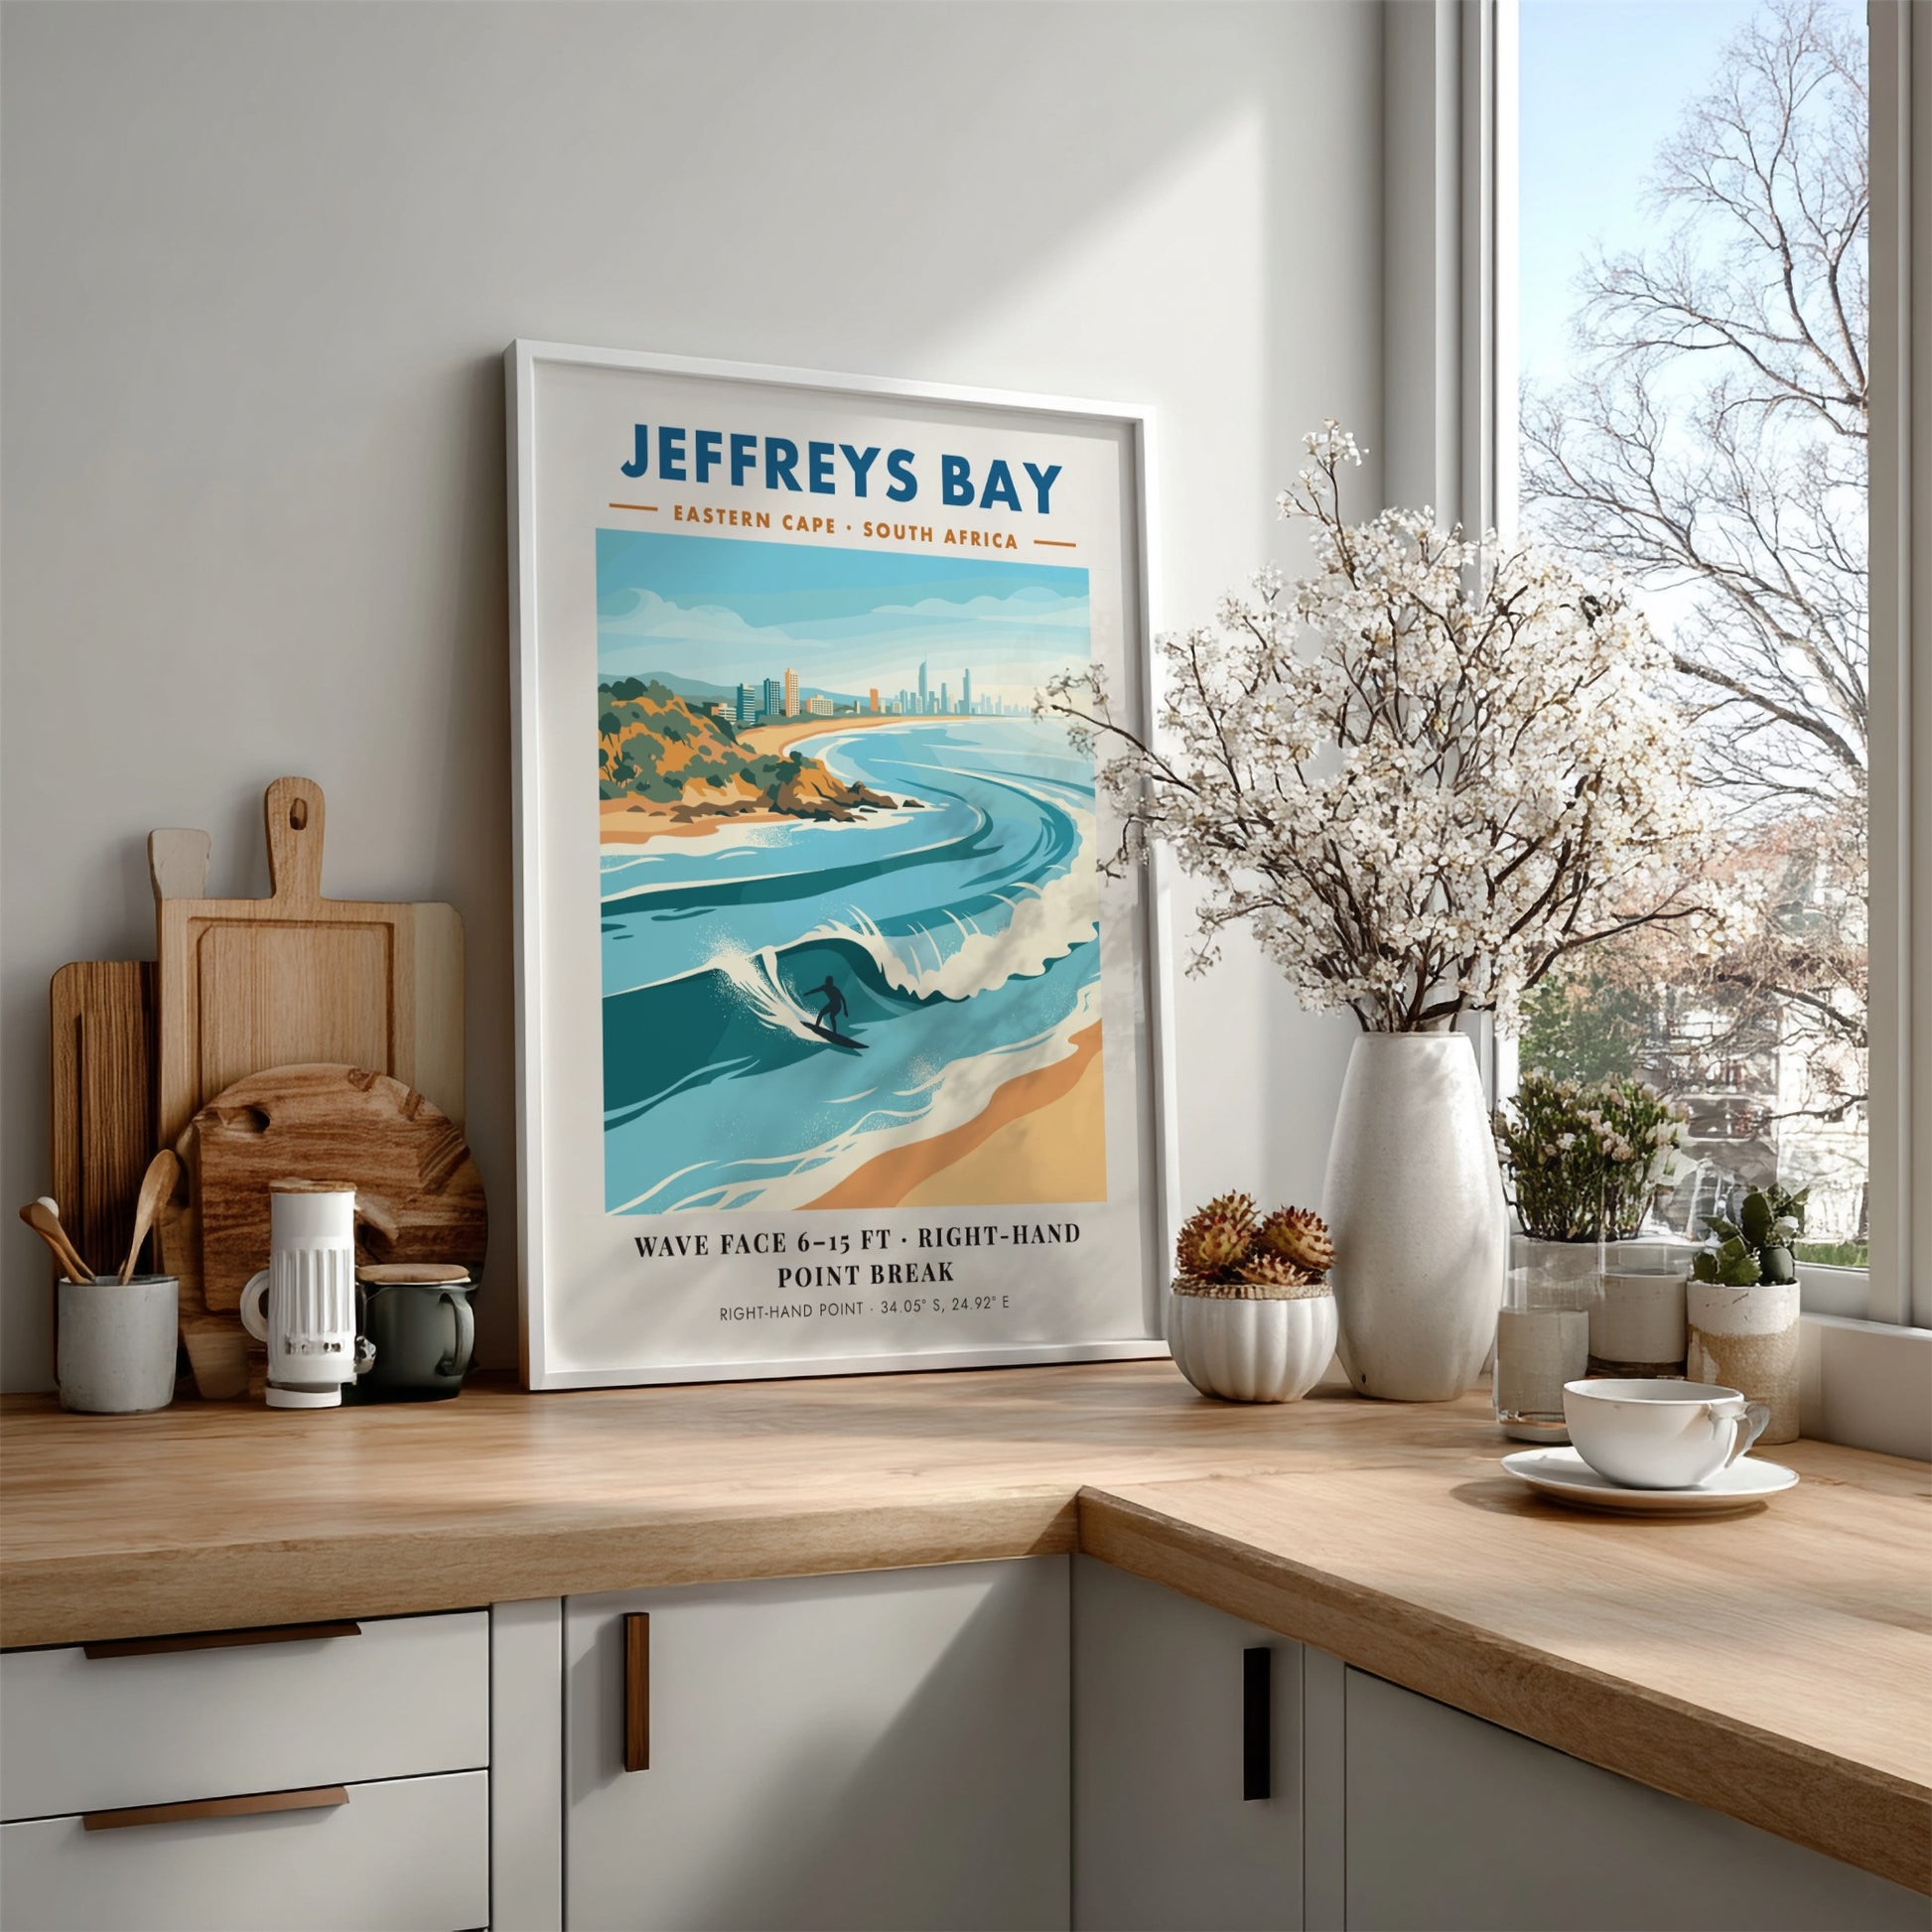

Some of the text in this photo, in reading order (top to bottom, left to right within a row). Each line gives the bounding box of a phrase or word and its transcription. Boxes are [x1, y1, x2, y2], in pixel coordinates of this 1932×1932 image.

[621, 424, 1062, 514] JEFFREYS BAY
[674, 504, 1017, 549] EASTERN CAPE SOUTH AFRICA
[634, 1235, 708, 1257] WAVE
[721, 1233, 785, 1254] FACE
[862, 1229, 890, 1249] FT
[918, 1224, 1079, 1247] RIGHT-HAND
[778, 1262, 953, 1288] POINT BREAK
[721, 1295, 1010, 1320] RIGHT-HAND POINT 34.05° S, 24.92° E
